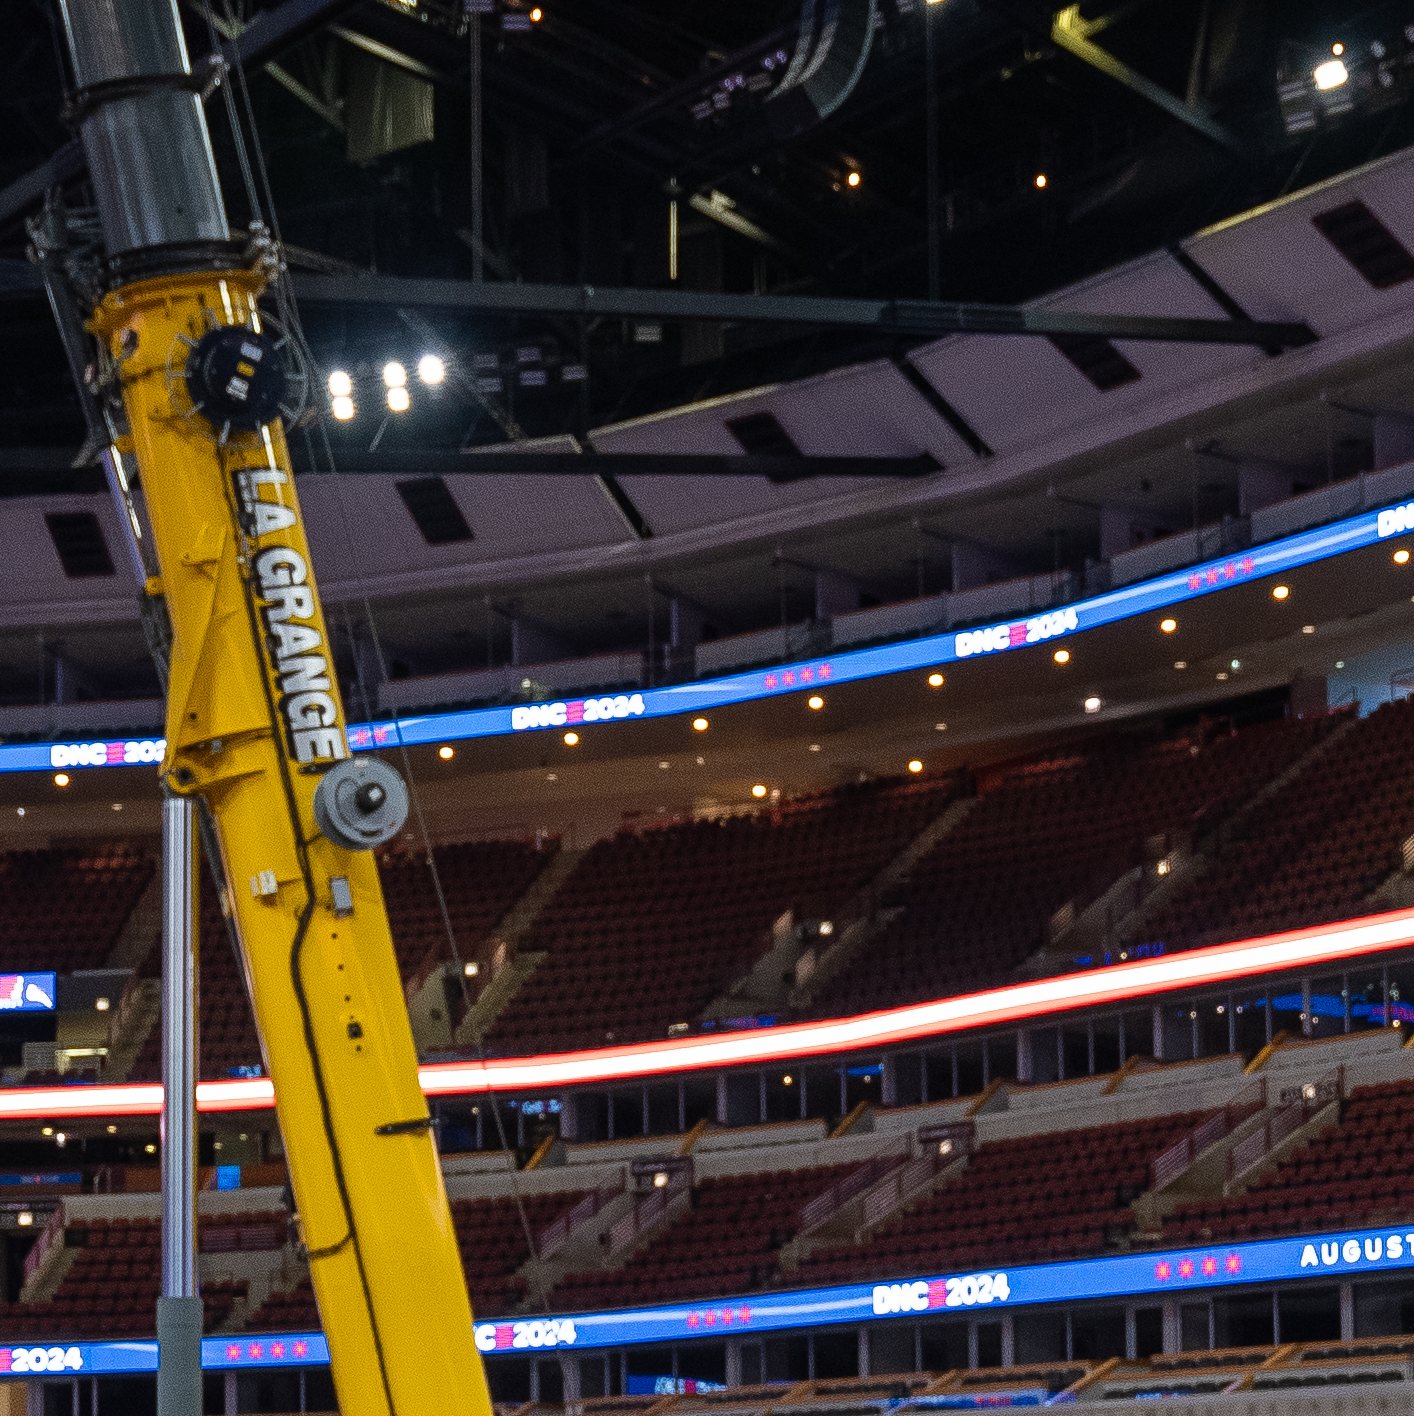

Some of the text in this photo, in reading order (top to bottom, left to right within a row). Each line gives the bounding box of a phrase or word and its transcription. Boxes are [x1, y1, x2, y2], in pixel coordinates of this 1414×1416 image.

[237, 466, 345, 764] LA GRANGE
[955, 606, 1079, 657] DNC 2024
[511, 694, 646, 731] DNC 2024
[124, 740, 167, 763] 202
[872, 1272, 1012, 1315] DNC 2024
[512, 1319, 577, 1348] 2024
[10, 1346, 84, 1372] 2024
